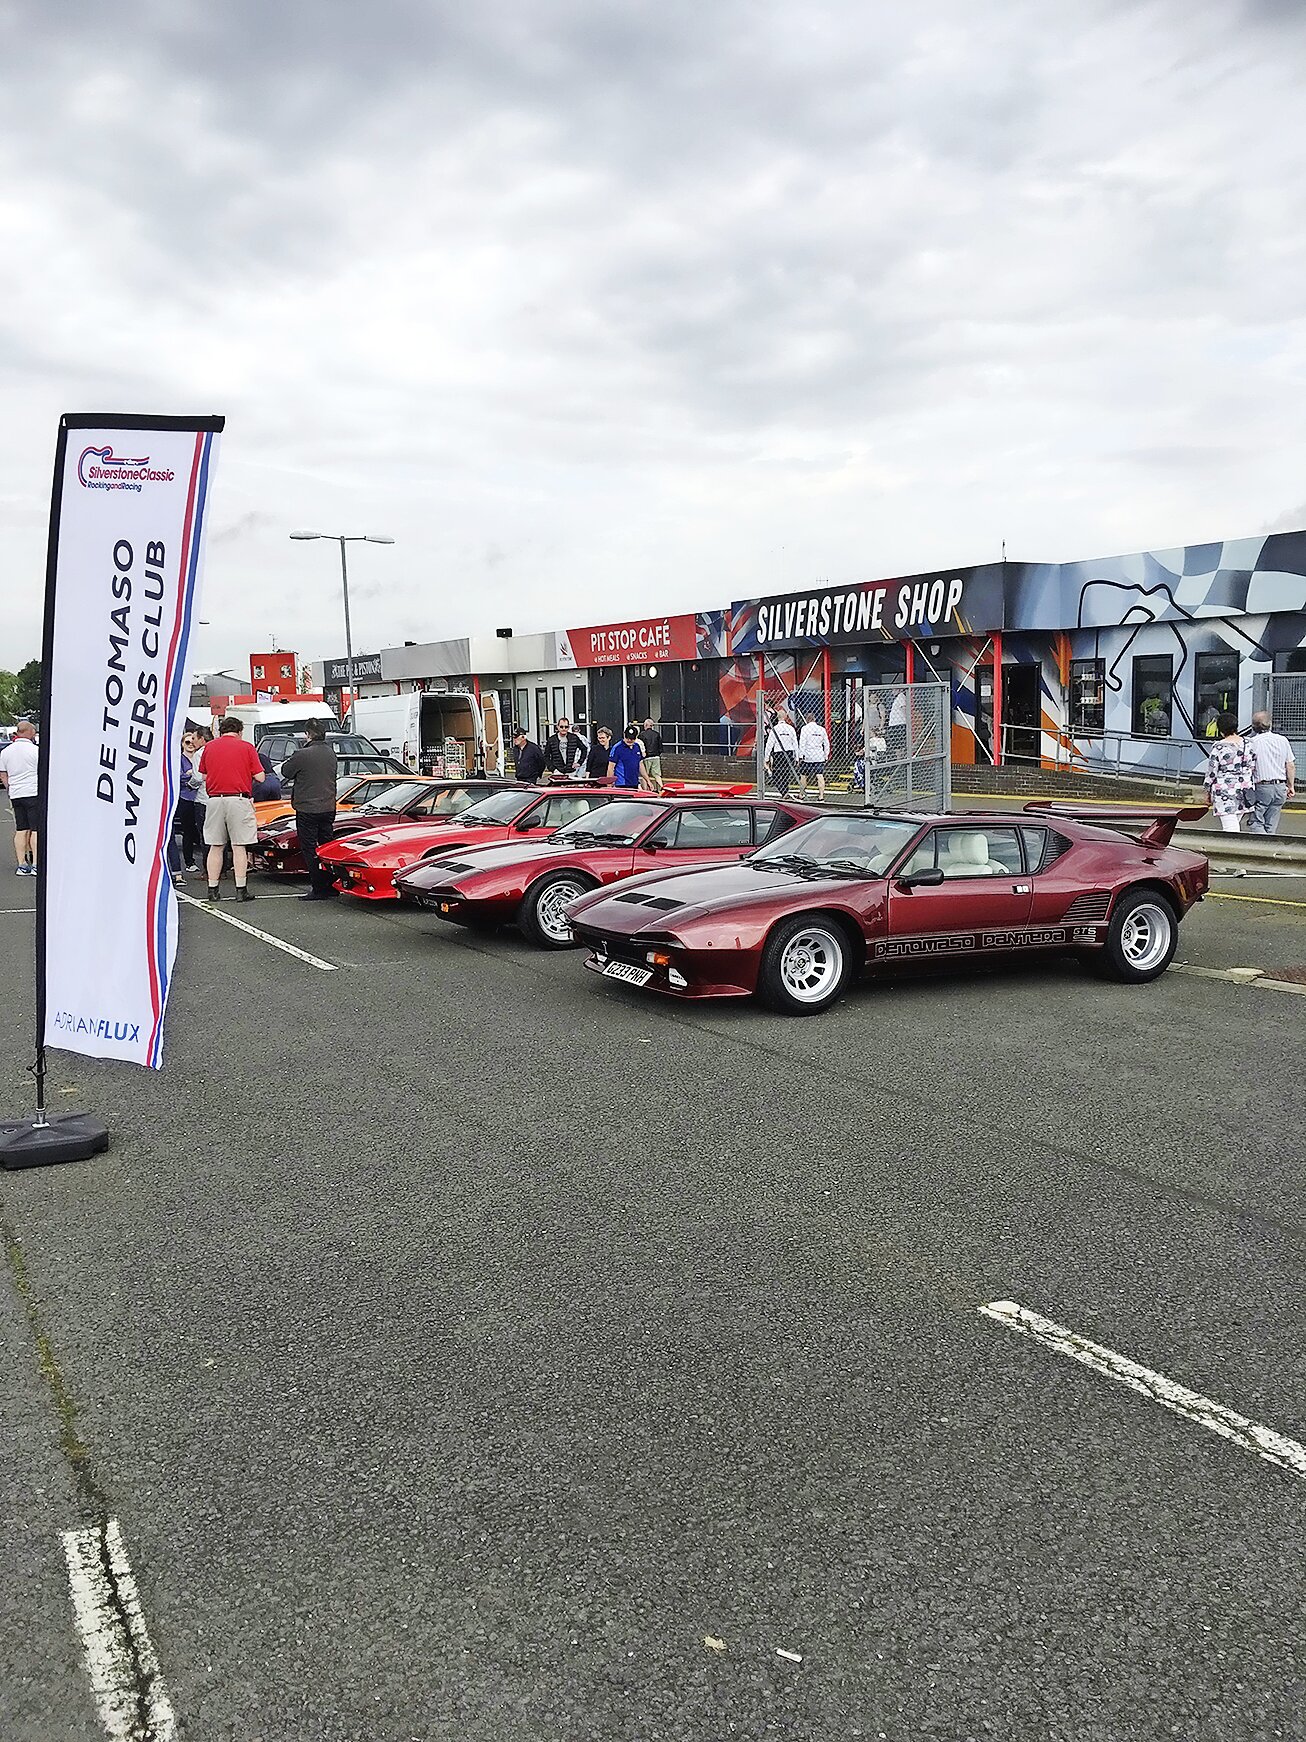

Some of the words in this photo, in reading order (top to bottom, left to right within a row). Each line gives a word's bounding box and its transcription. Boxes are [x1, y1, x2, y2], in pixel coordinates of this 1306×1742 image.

[756, 587, 887, 644] SILVERSTONE
[894, 579, 963, 629] SHOP
[103, 539, 134, 732] TOMASO
[590, 632, 606, 652] PIT
[608, 629, 637, 651] STOP
[639, 619, 671, 648] CAFÉ
[597, 655, 606, 663] HOT
[606, 654, 620, 662] MEALS
[630, 652, 648, 660] SNACKS
[659, 650, 669, 658] BAR
[124, 670, 157, 865] OWNERS
[141, 539, 165, 659] CLUB
[96, 743, 117, 804] DE
[1073, 927, 1097, 935] GTS
